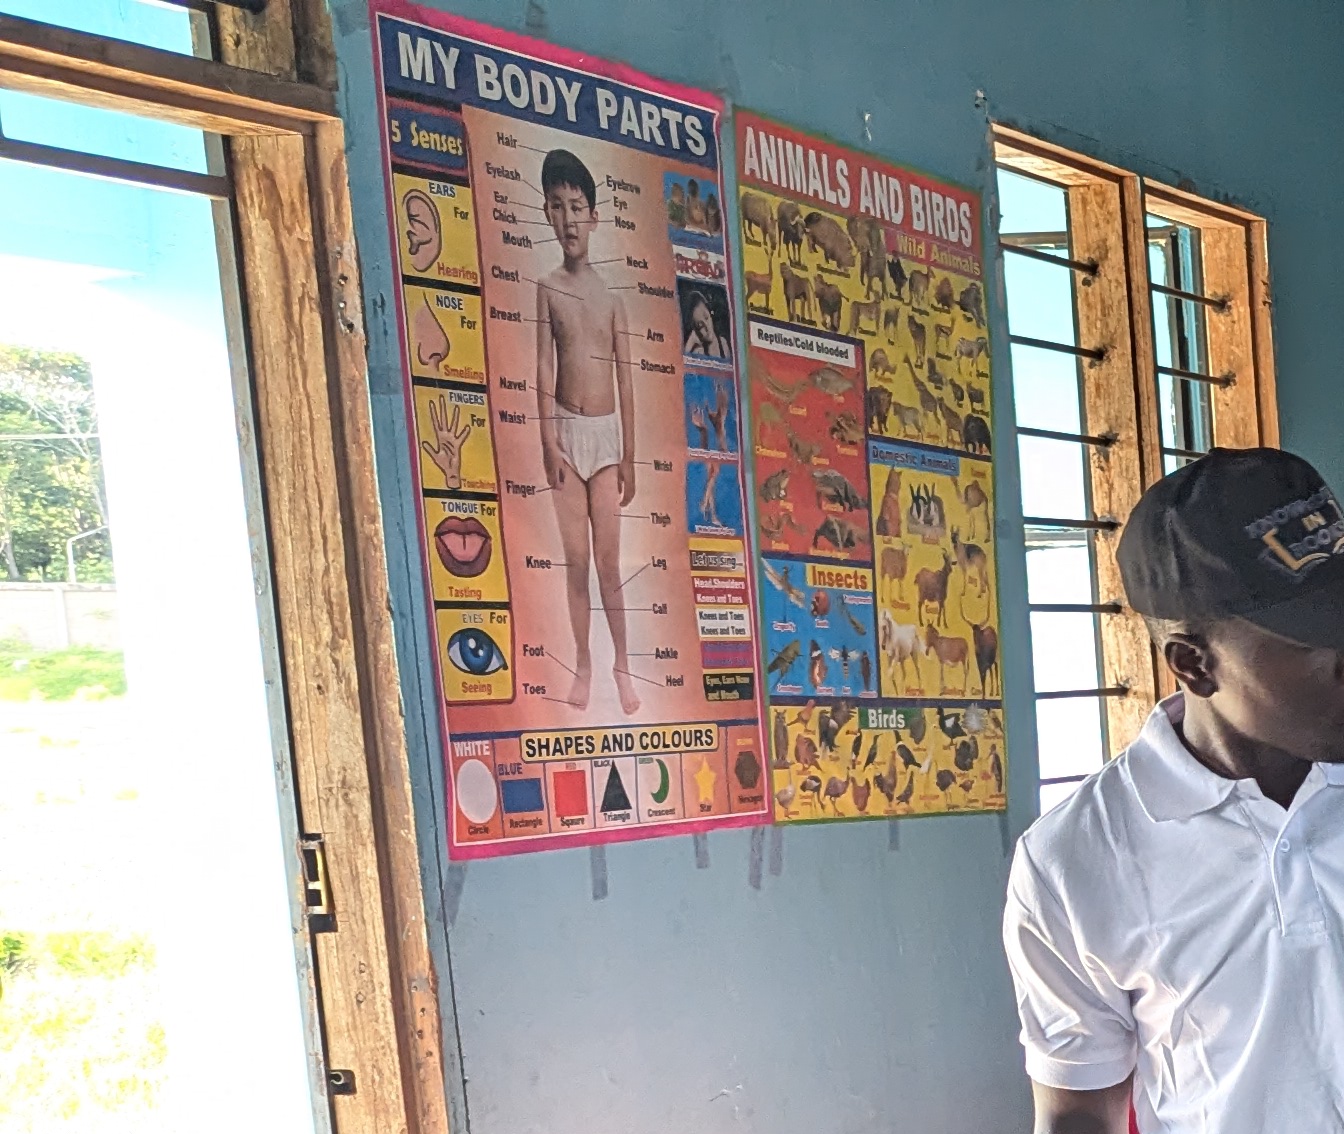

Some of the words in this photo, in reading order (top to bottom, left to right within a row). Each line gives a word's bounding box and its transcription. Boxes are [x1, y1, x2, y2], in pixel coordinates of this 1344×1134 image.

[397, 31, 459, 90] MY
[474, 53, 582, 122] BODY
[596, 87, 707, 156] PARTS
[392, 121, 401, 142] 5
[411, 121, 463, 156] Senses
[497, 132, 517, 148] Hair
[486, 162, 521, 181] Eyelash
[428, 182, 455, 198] EARS
[606, 175, 641, 194] Eyebrow
[744, 126, 850, 208] ANIMALS
[860, 167, 904, 224] AND
[909, 184, 973, 248] BIRDS
[494, 192, 508, 205] Ear
[613, 197, 628, 211] Eye
[454, 207, 468, 221] For
[493, 208, 517, 224] Chick
[615, 216, 636, 231] Nose
[502, 231, 532, 249] Mouth
[897, 235, 925, 259] Wild
[931, 244, 981, 275] Animals
[626, 257, 648, 270] Neck
[437, 262, 478, 284] Hearing
[491, 266, 519, 282] Chest
[638, 282, 673, 299] Shoulder
[436, 295, 464, 310] NOSE
[490, 307, 521, 323] Breast
[461, 316, 476, 330] For
[647, 328, 664, 343] Arm
[816, 341, 849, 359] blooded
[640, 360, 675, 374] Stomach
[444, 366, 484, 383] Smelling
[500, 377, 526, 391] Navel
[449, 392, 484, 406] FINGERS
[471, 414, 486, 428] For
[500, 411, 526, 424] Waist
[872, 447, 917, 465] Domestic
[921, 456, 957, 470] Animals
[654, 460, 673, 472] Wrist
[506, 481, 536, 496] Finger
[441, 501, 479, 515] TONGUE
[480, 503, 496, 517] For
[651, 512, 671, 527] Thigh
[526, 556, 552, 568] Knee
[652, 557, 667, 570] Leg
[812, 566, 867, 589] Insects
[448, 586, 482, 600] Tasting
[697, 594, 715, 602] Knees
[716, 595, 726, 603] and
[727, 595, 743, 603] Toes
[652, 603, 667, 615] Calf
[699, 611, 717, 620] Knees
[718, 612, 728, 620] and
[729, 612, 744, 620] Toes
[462, 613, 484, 624] EYES
[489, 612, 508, 625] For
[701, 626, 719, 635] Knees
[720, 627, 729, 635] and
[731, 626, 746, 635] Toes
[522, 644, 545, 657] Foot
[654, 648, 678, 659] Ankle
[666, 676, 684, 687] Heel
[461, 682, 492, 696] Seeing
[522, 683, 546, 695] Toes
[868, 709, 906, 729] Birds
[454, 741, 491, 757] WHITE
[525, 735, 595, 757] SHAPES
[601, 733, 634, 753] AND
[639, 729, 714, 749] COLOURS
[498, 763, 522, 776] BLUE
[604, 811, 631, 822] Triangle
[647, 807, 676, 818] Crescent
[509, 817, 543, 828] Rectangle
[468, 825, 489, 835] Circle
